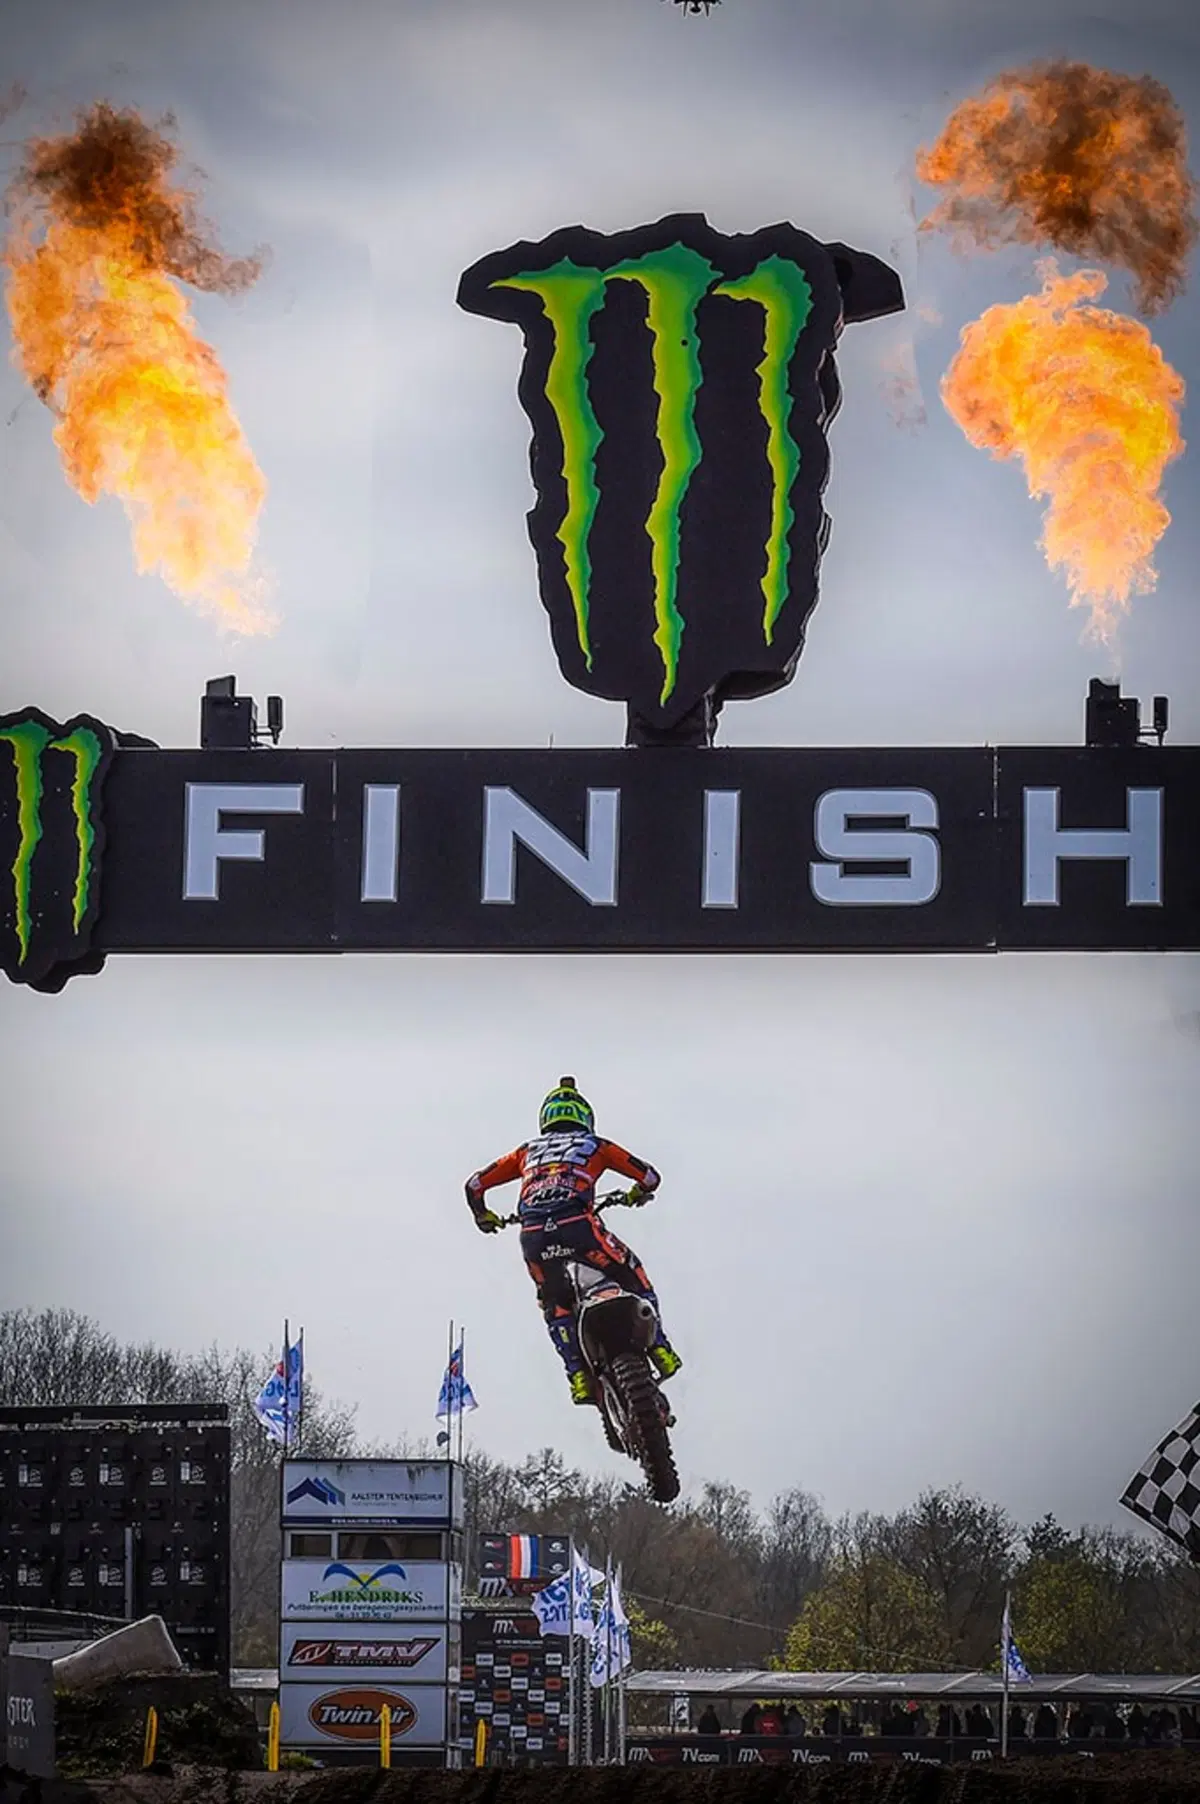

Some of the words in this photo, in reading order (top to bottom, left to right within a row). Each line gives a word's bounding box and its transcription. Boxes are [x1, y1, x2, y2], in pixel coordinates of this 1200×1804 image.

[181, 781, 1166, 909] FINISH
[332, 1590, 424, 1604] HENDRIKS
[336, 1643, 428, 1657] TMV
[320, 1706, 372, 1723] Twin
